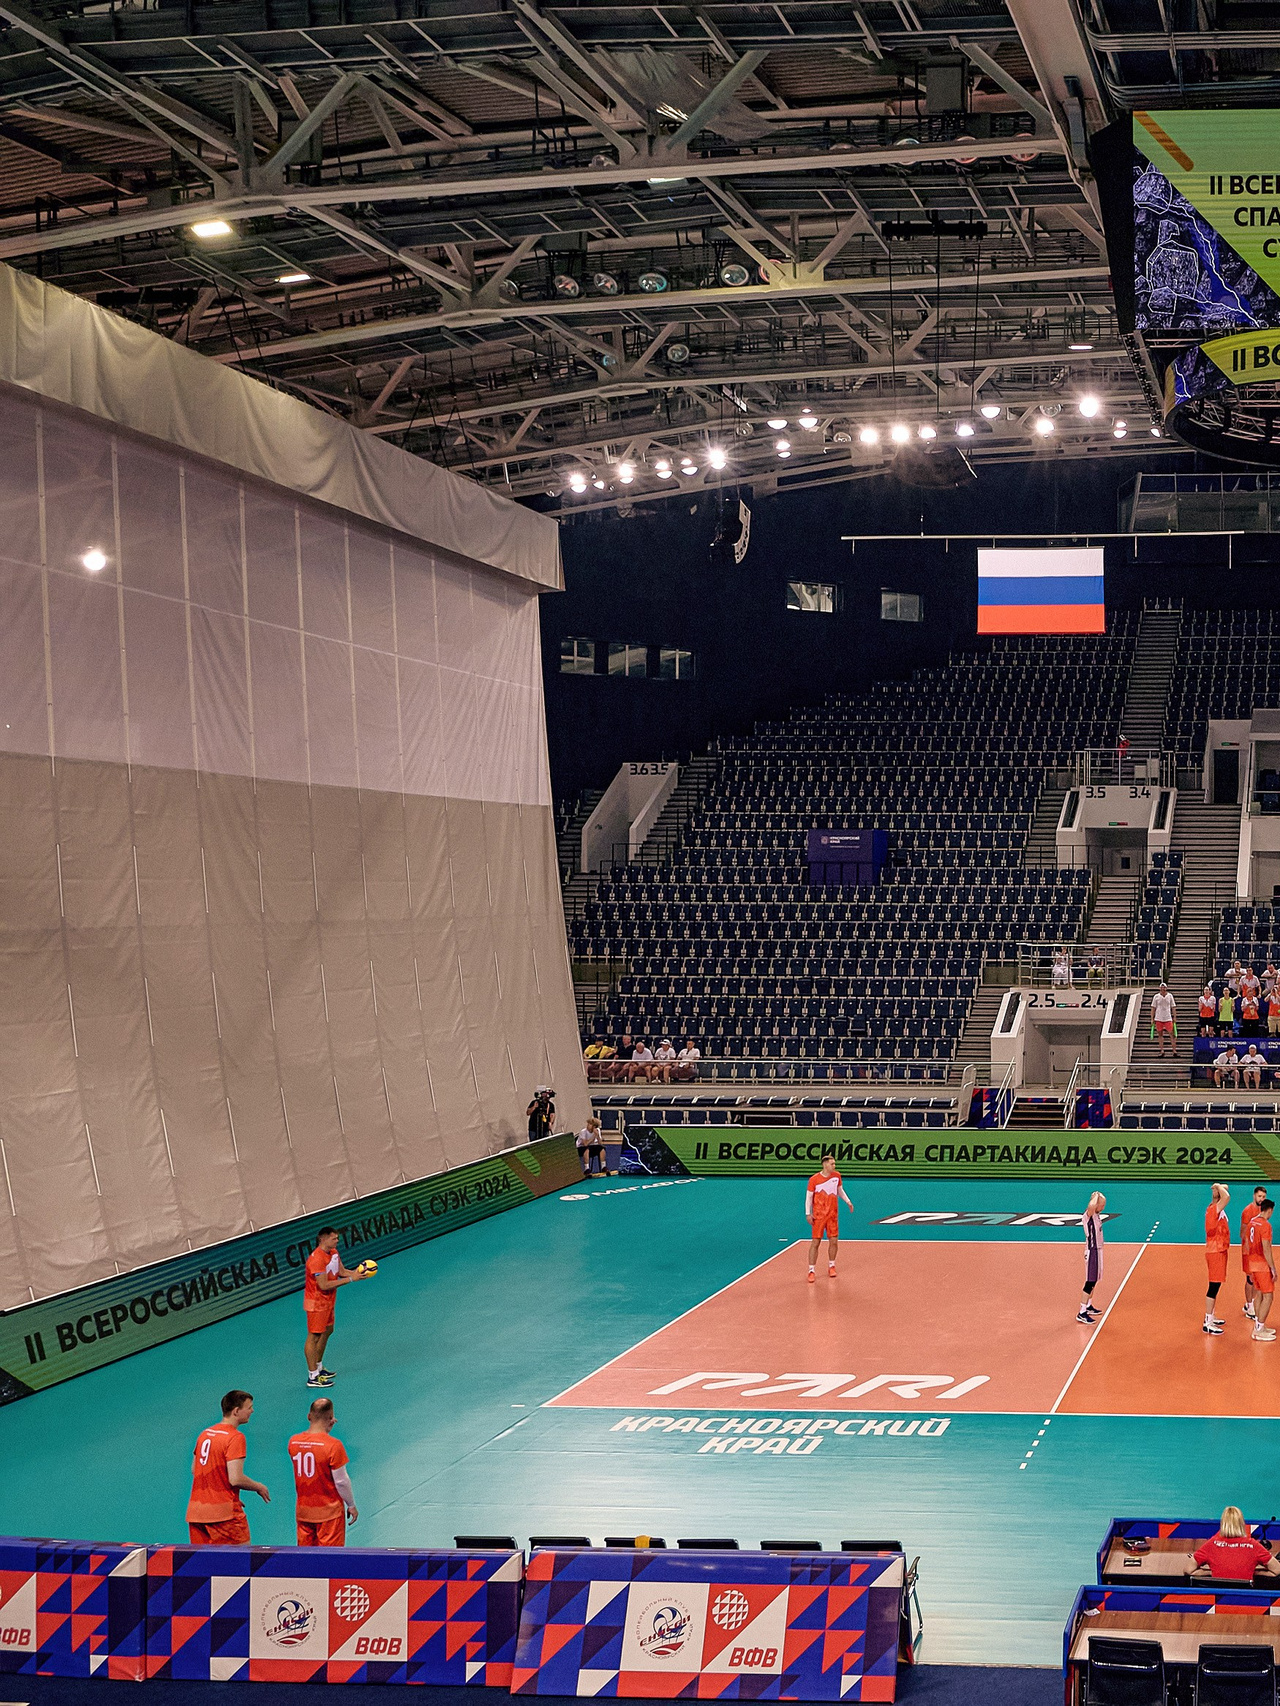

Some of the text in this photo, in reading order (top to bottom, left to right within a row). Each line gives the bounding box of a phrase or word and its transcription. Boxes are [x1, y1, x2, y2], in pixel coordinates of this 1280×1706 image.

[1085, 786, 1151, 798] 3.5 3.4
[1028, 993, 1108, 1008] 2.5 2.4
[718, 1138, 914, 1163] ВСЕРОССИЙСКАЯ
[924, 1144, 1098, 1167] СПАРТАКИАДА
[1107, 1145, 1167, 1166] СУЭК
[1176, 1147, 1233, 1165] 2024
[591, 1176, 706, 1197] МЕГАФОН
[55, 1251, 280, 1353] ВСЕРОССИЙСКАЯ
[285, 1203, 426, 1268] СПТАКИАДА
[430, 1190, 472, 1217] СУЭК
[474, 1173, 511, 1200] 2024
[646, 1372, 991, 1399] PARI
[609, 1416, 952, 1436] КРАСНОЯРСКИЙ
[200, 1438, 211, 1466] 9
[697, 1434, 824, 1455] КРАЙ
[292, 1451, 316, 1478] 10
[0, 1627, 31, 1646] ФВ
[355, 1637, 402, 1655] ВФВ
[728, 1647, 778, 1667] ВФВ
